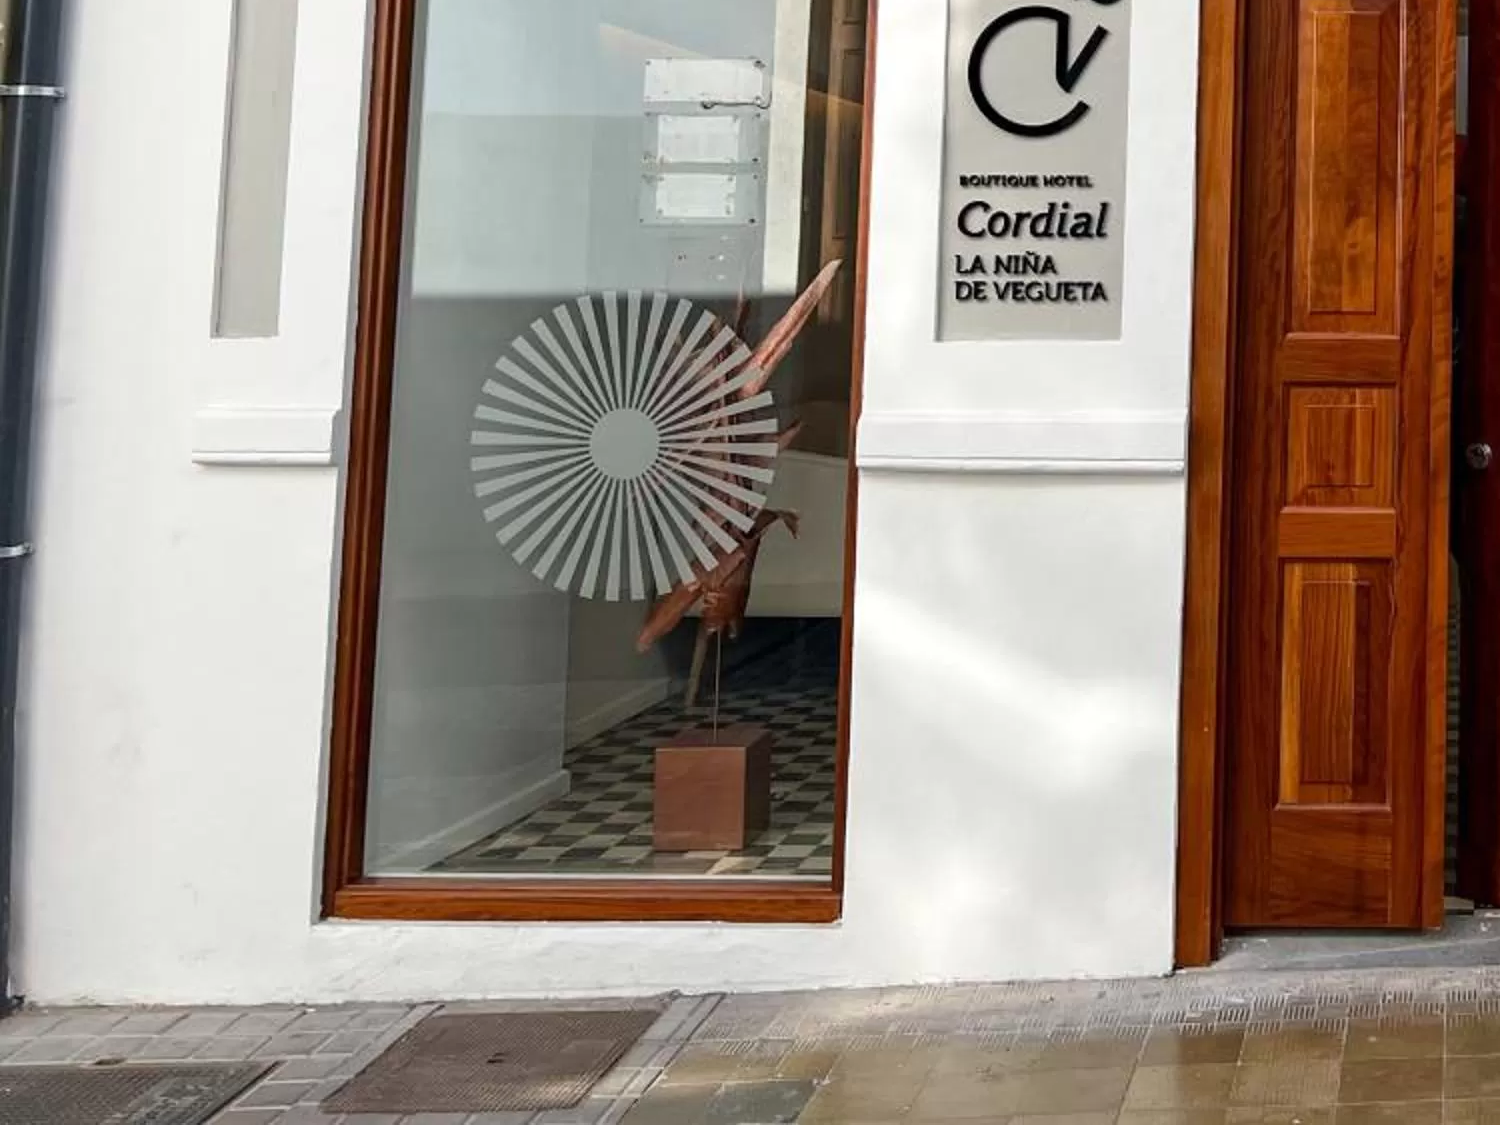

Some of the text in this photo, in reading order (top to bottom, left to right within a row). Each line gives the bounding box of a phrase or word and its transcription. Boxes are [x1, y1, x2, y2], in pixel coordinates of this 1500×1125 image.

[959, 175, 1093, 188] BOUTIQUE HOTEL
[957, 200, 1109, 238] Cordial
[955, 250, 1058, 275] LA NIÑA
[955, 281, 1109, 302] DE VEGUETA
